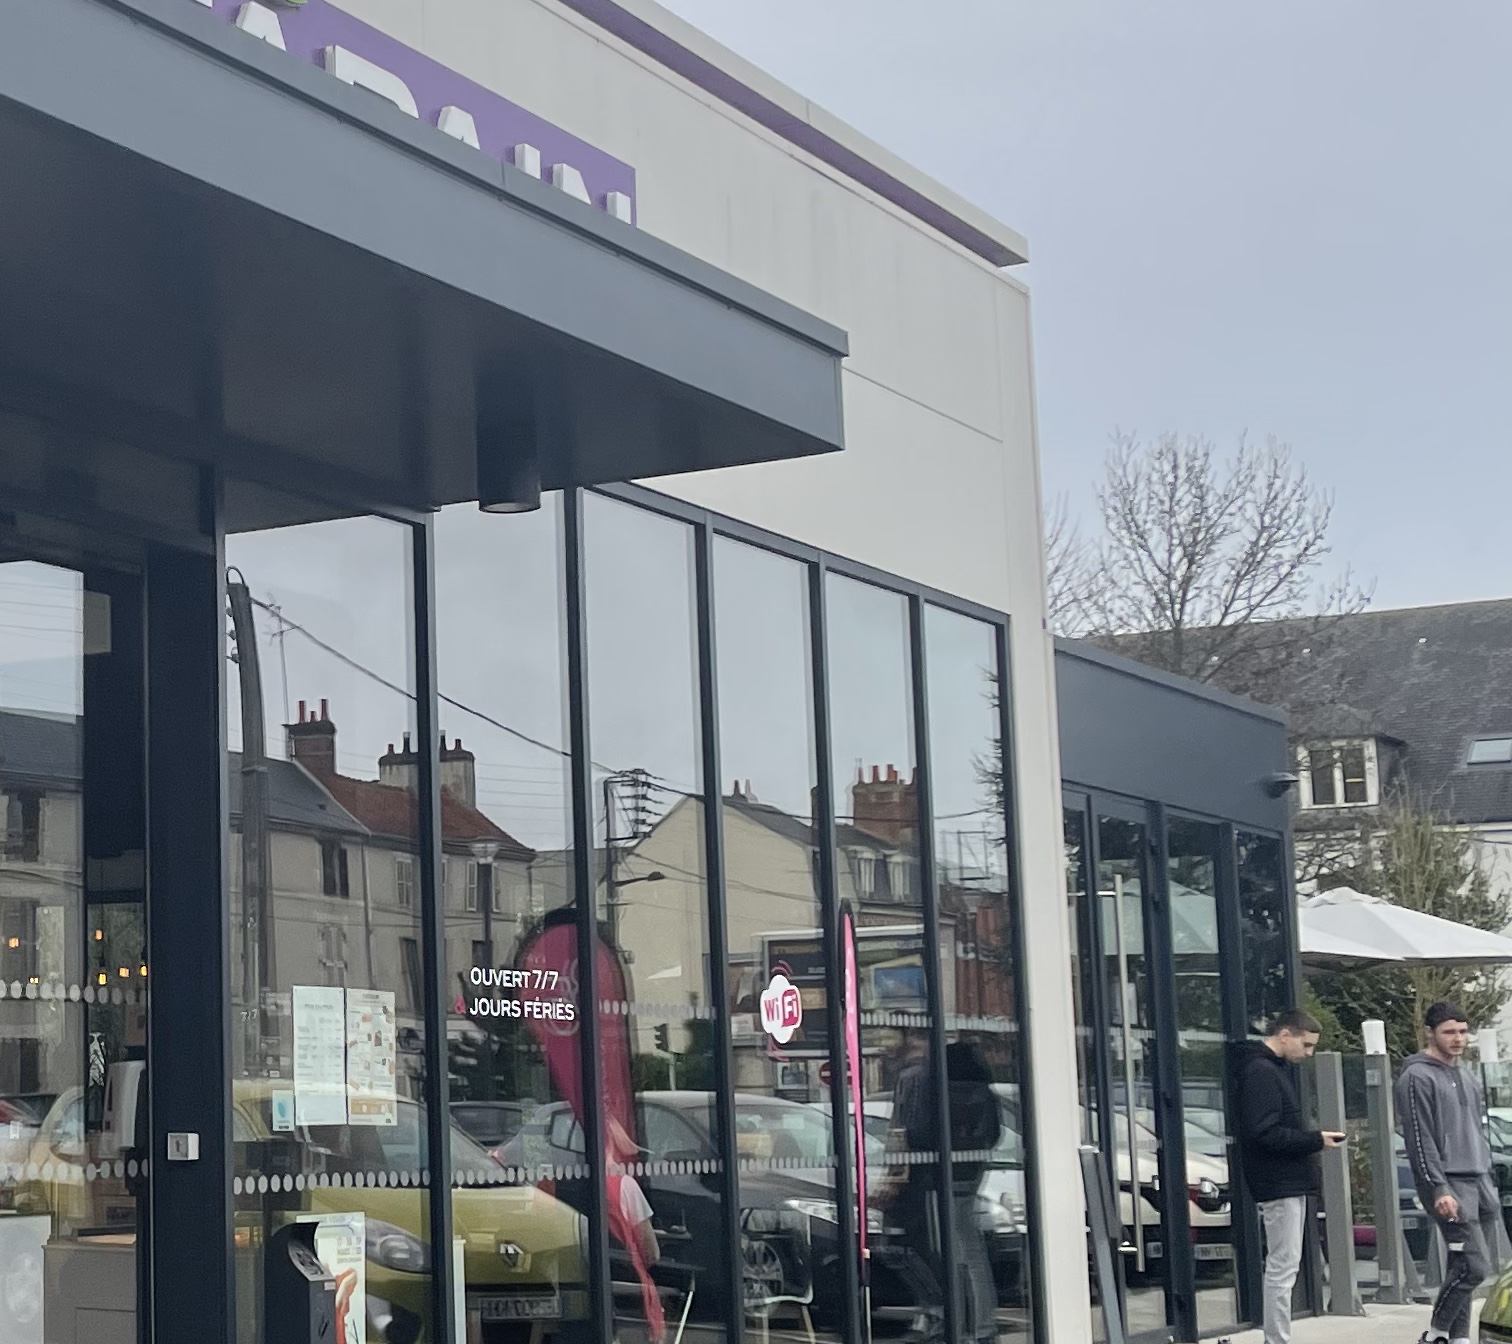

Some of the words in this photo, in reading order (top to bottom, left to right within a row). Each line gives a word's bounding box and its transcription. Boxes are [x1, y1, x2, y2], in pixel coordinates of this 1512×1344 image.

[470, 966, 531, 989] OUVERT
[532, 969, 559, 990] 7/7
[469, 997, 522, 1018] JOURS
[524, 996, 575, 1020] FÉRIÉS
